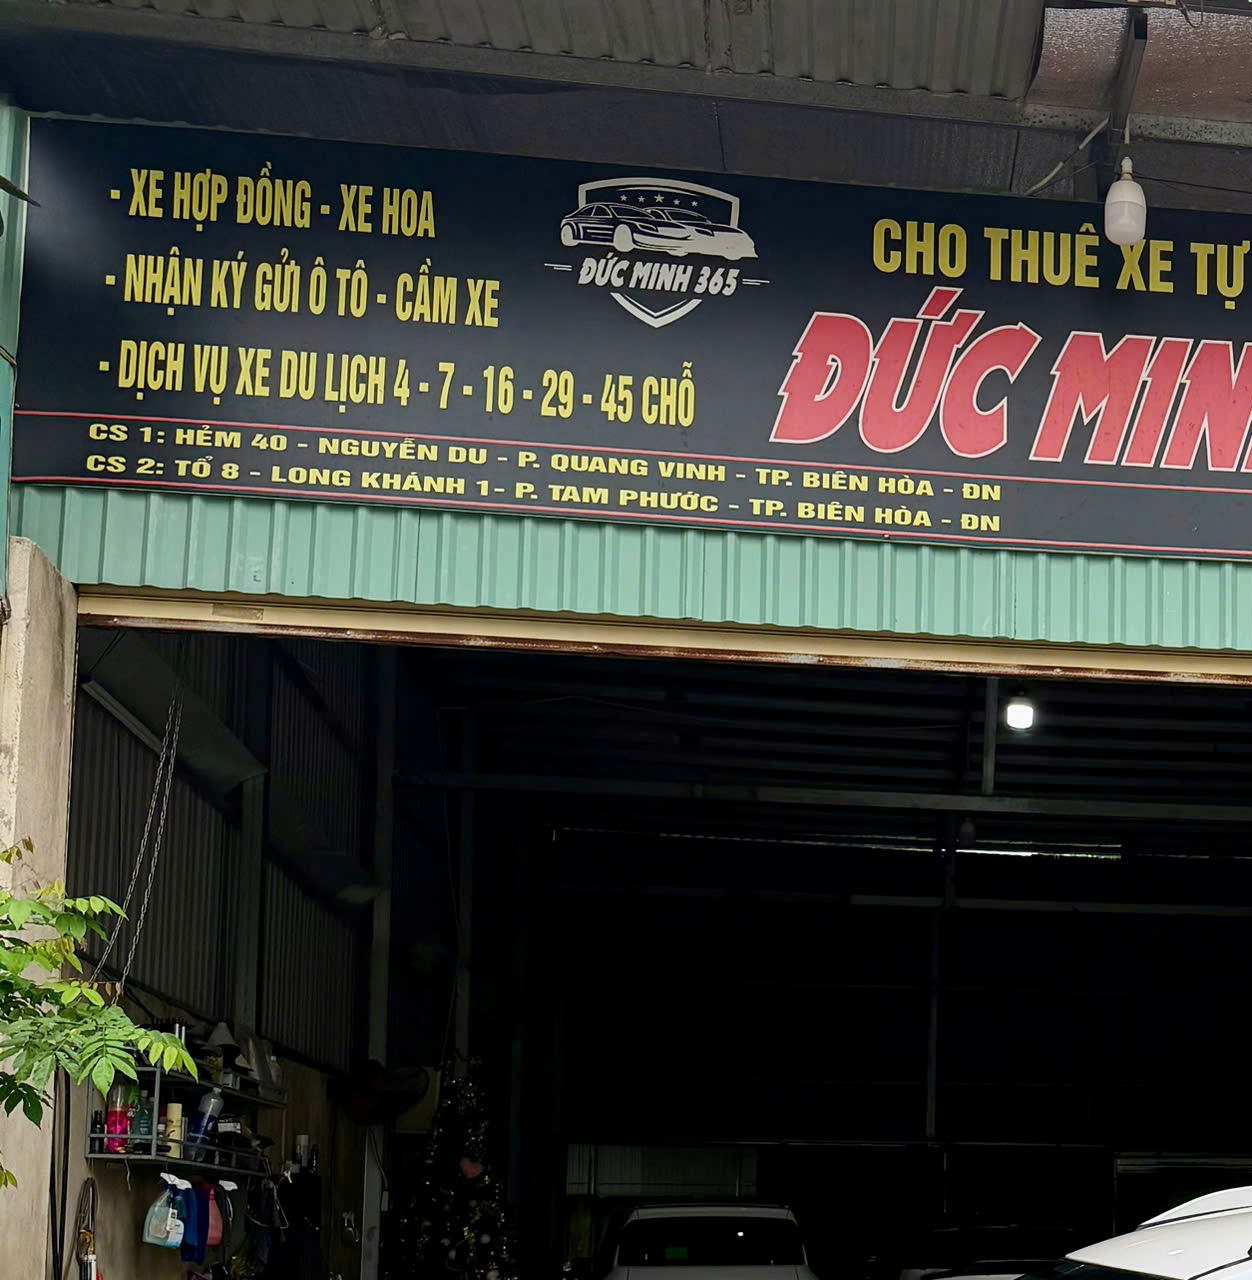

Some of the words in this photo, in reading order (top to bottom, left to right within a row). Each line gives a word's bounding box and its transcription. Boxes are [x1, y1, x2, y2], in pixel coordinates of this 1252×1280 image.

[128, 169, 164, 218] XE
[172, 168, 228, 232] HỢP
[236, 161, 312, 229] ĐỒNG
[338, 183, 373, 233] XE
[381, 187, 436, 238] HOA
[123, 247, 204, 316] NHẬN
[210, 251, 248, 309] KÝ
[254, 247, 301, 313] GỬI
[308, 256, 328, 316] Ô
[335, 259, 369, 318] TÔ
[395, 258, 458, 325] CẦM
[464, 279, 500, 328] XE
[578, 253, 629, 287] ĐỨC
[628, 261, 693, 293] MINH
[694, 266, 740, 296] 365
[872, 218, 967, 278] CHO
[983, 223, 1100, 289] THUÊ
[1116, 239, 1174, 294] XE
[1189, 240, 1251, 310] TỰ
[117, 339, 185, 401] DỊCH
[193, 343, 229, 406] VỤ
[234, 346, 272, 398] XE
[279, 351, 318, 401] DU
[323, 353, 387, 414] LỊCH
[391, 359, 411, 407] 4
[437, 361, 456, 410] 7
[482, 367, 515, 415] 16
[540, 368, 575, 419] 29
[599, 375, 634, 425] 45
[640, 361, 696, 428] CHỖ
[769, 286, 1042, 459] ĐỨC
[86, 455, 127, 473] CS
[175, 455, 212, 479] TỔ
[220, 463, 240, 480] 8
[271, 465, 352, 489] LONG
[359, 471, 465, 497] KHÁNH
[514, 482, 537, 501] P.
[548, 485, 609, 505] TAM
[616, 489, 719, 513] PHƯỚC
[749, 499, 785, 517] TP.
[796, 501, 865, 523] BIÊN
[873, 506, 932, 528] HÒA
[959, 513, 1001, 533] ĐN
[88, 423, 128, 442] CS
[175, 423, 242, 449] HẺM
[250, 434, 288, 452] 40
[318, 437, 439, 462] NGUYỄN
[447, 447, 489, 465] DU
[517, 451, 540, 469] P.
[550, 455, 649, 477] QUANG
[655, 461, 727, 483] VINH
[755, 468, 792, 489] TP.
[802, 471, 869, 493] BIÊN
[877, 474, 934, 497] HÒA
[961, 482, 1001, 502] ĐN
